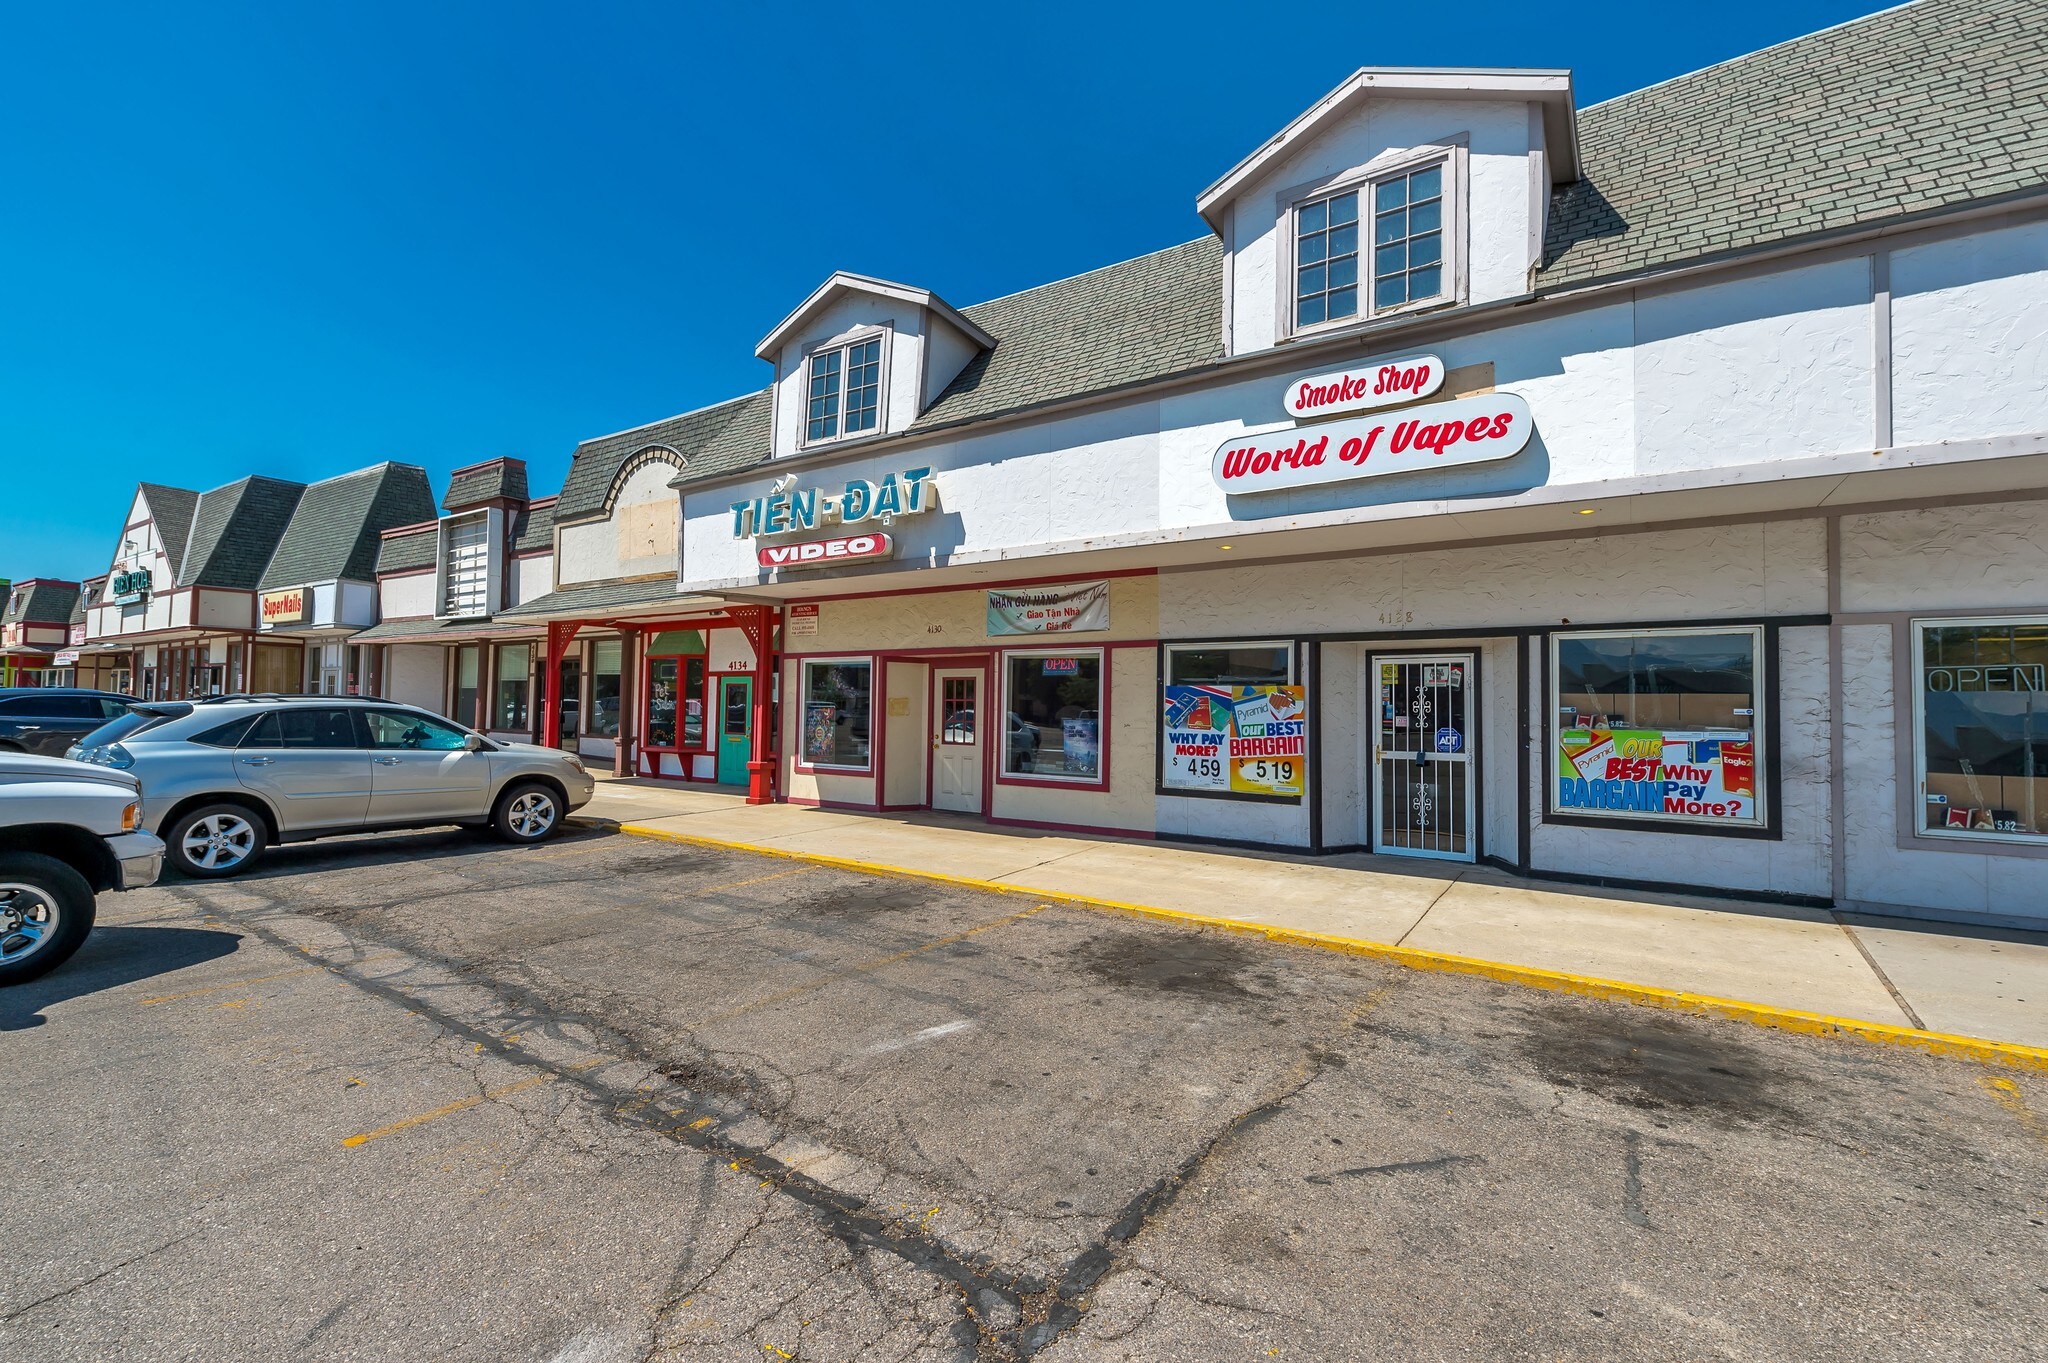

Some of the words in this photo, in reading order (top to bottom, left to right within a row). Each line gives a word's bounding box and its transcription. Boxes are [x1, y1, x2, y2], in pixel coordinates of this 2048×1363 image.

[1295, 375, 1367, 410] Smoke
[1374, 364, 1431, 395] Shop
[1222, 436, 1329, 480] World
[1339, 425, 1386, 466] of
[1390, 412, 1514, 455] Vapes
[768, 537, 876, 563] VIDEO
[264, 593, 302, 619] SuperNails
[1027, 609, 1044, 619] Giao
[1064, 606, 1080, 617] Nhà
[927, 624, 942, 634] 4130
[1046, 621, 1060, 631] Giá
[728, 661, 748, 671] 4134
[1044, 657, 1077, 670] OPEN
[1928, 667, 2040, 693] OPEN
[1237, 703, 1269, 721] Pyramid
[1242, 724, 1265, 737] our
[1266, 721, 1303, 737] BEST
[1168, 733, 1199, 745] WHY
[1201, 734, 1226, 746] PAY
[1230, 735, 1304, 757] BARGAIN
[1439, 736, 1458, 745] ADT
[1622, 739, 1663, 759] OUR
[1175, 745, 1219, 757] MORE?
[1578, 745, 1615, 769] Pyramid
[1188, 758, 1220, 778] 4.59
[1256, 760, 1293, 781] 5.19
[1605, 758, 1662, 782] BEST
[1663, 764, 1713, 785] Why
[1560, 777, 1664, 813] BARGAIN
[1663, 782, 1707, 801] Pay
[1664, 798, 1742, 817] More?
